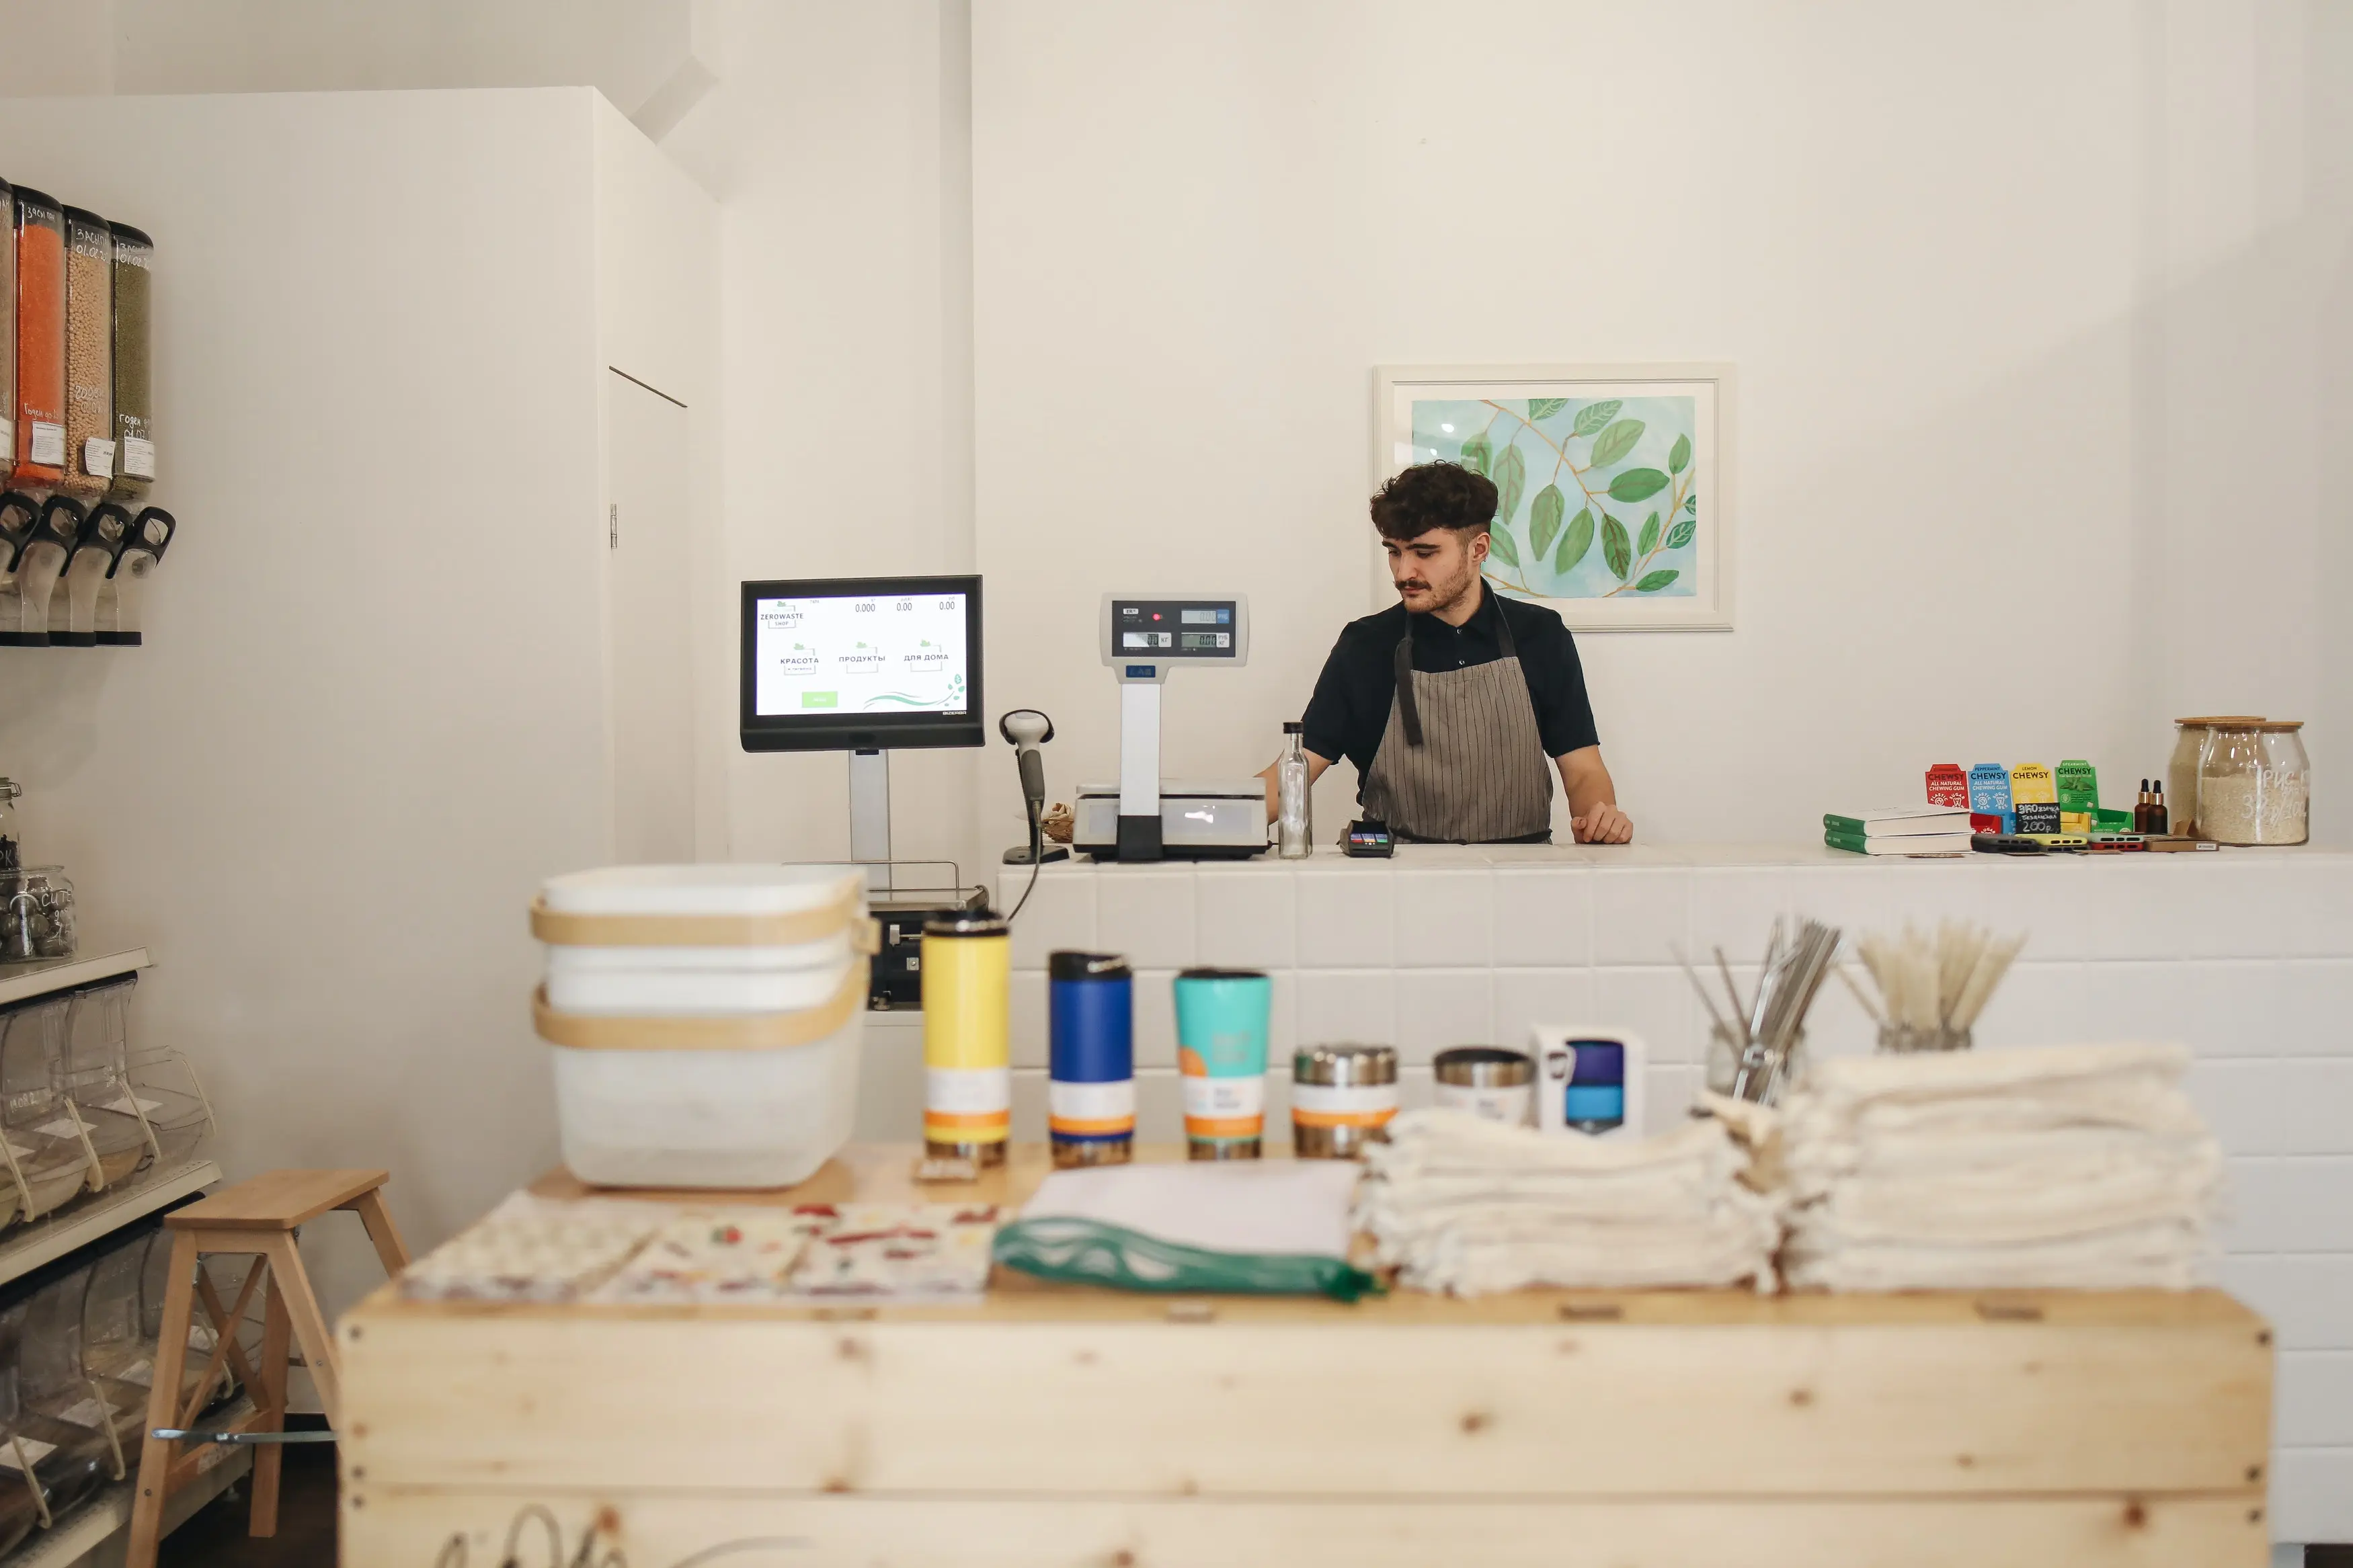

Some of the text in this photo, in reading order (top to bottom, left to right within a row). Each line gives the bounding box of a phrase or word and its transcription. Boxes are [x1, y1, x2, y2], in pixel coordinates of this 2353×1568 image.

[855, 604, 875, 612] 0.000
[896, 602, 912, 611] 0.00
[939, 601, 955, 610] 0.00
[1930, 792, 1948, 801] PLASTIC
